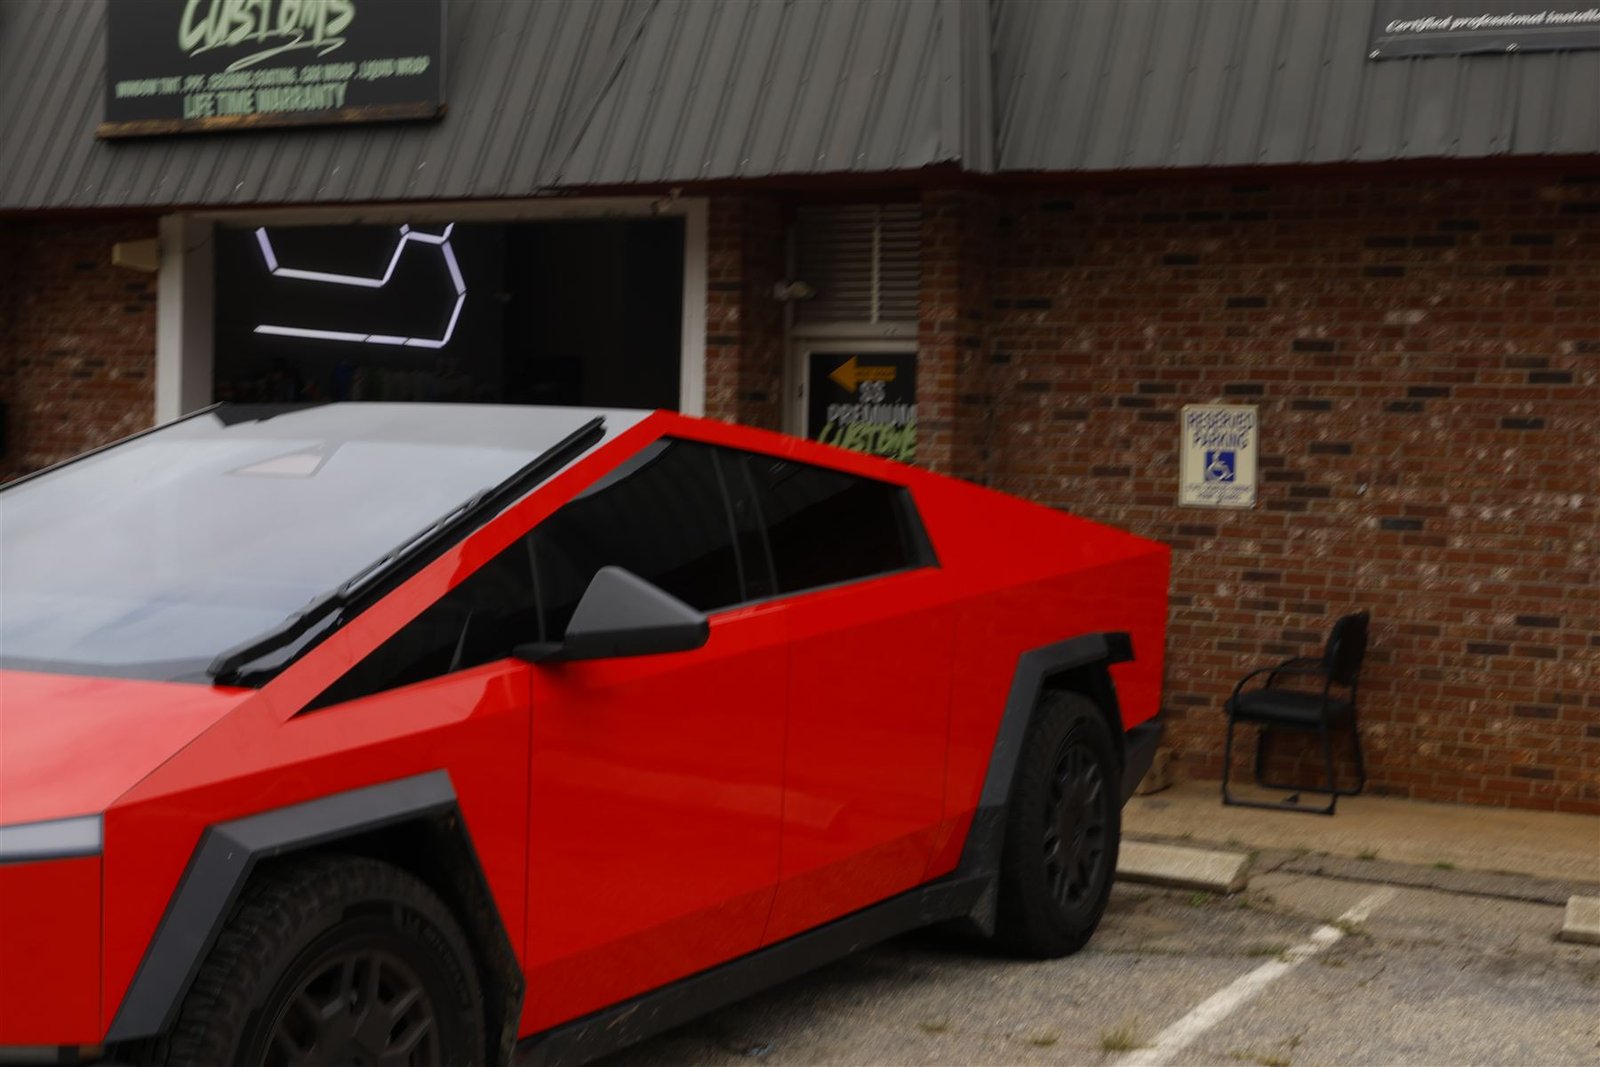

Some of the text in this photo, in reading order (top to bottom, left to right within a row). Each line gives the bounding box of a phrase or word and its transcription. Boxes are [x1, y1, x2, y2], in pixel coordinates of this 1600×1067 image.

[1385, 15, 1452, 33] Certified
[1449, 11, 1547, 31] professional
[183, 81, 348, 120] LIFE TIME WARRANTY
[1187, 410, 1255, 430] RESERVED
[1192, 430, 1249, 450] PARKING
